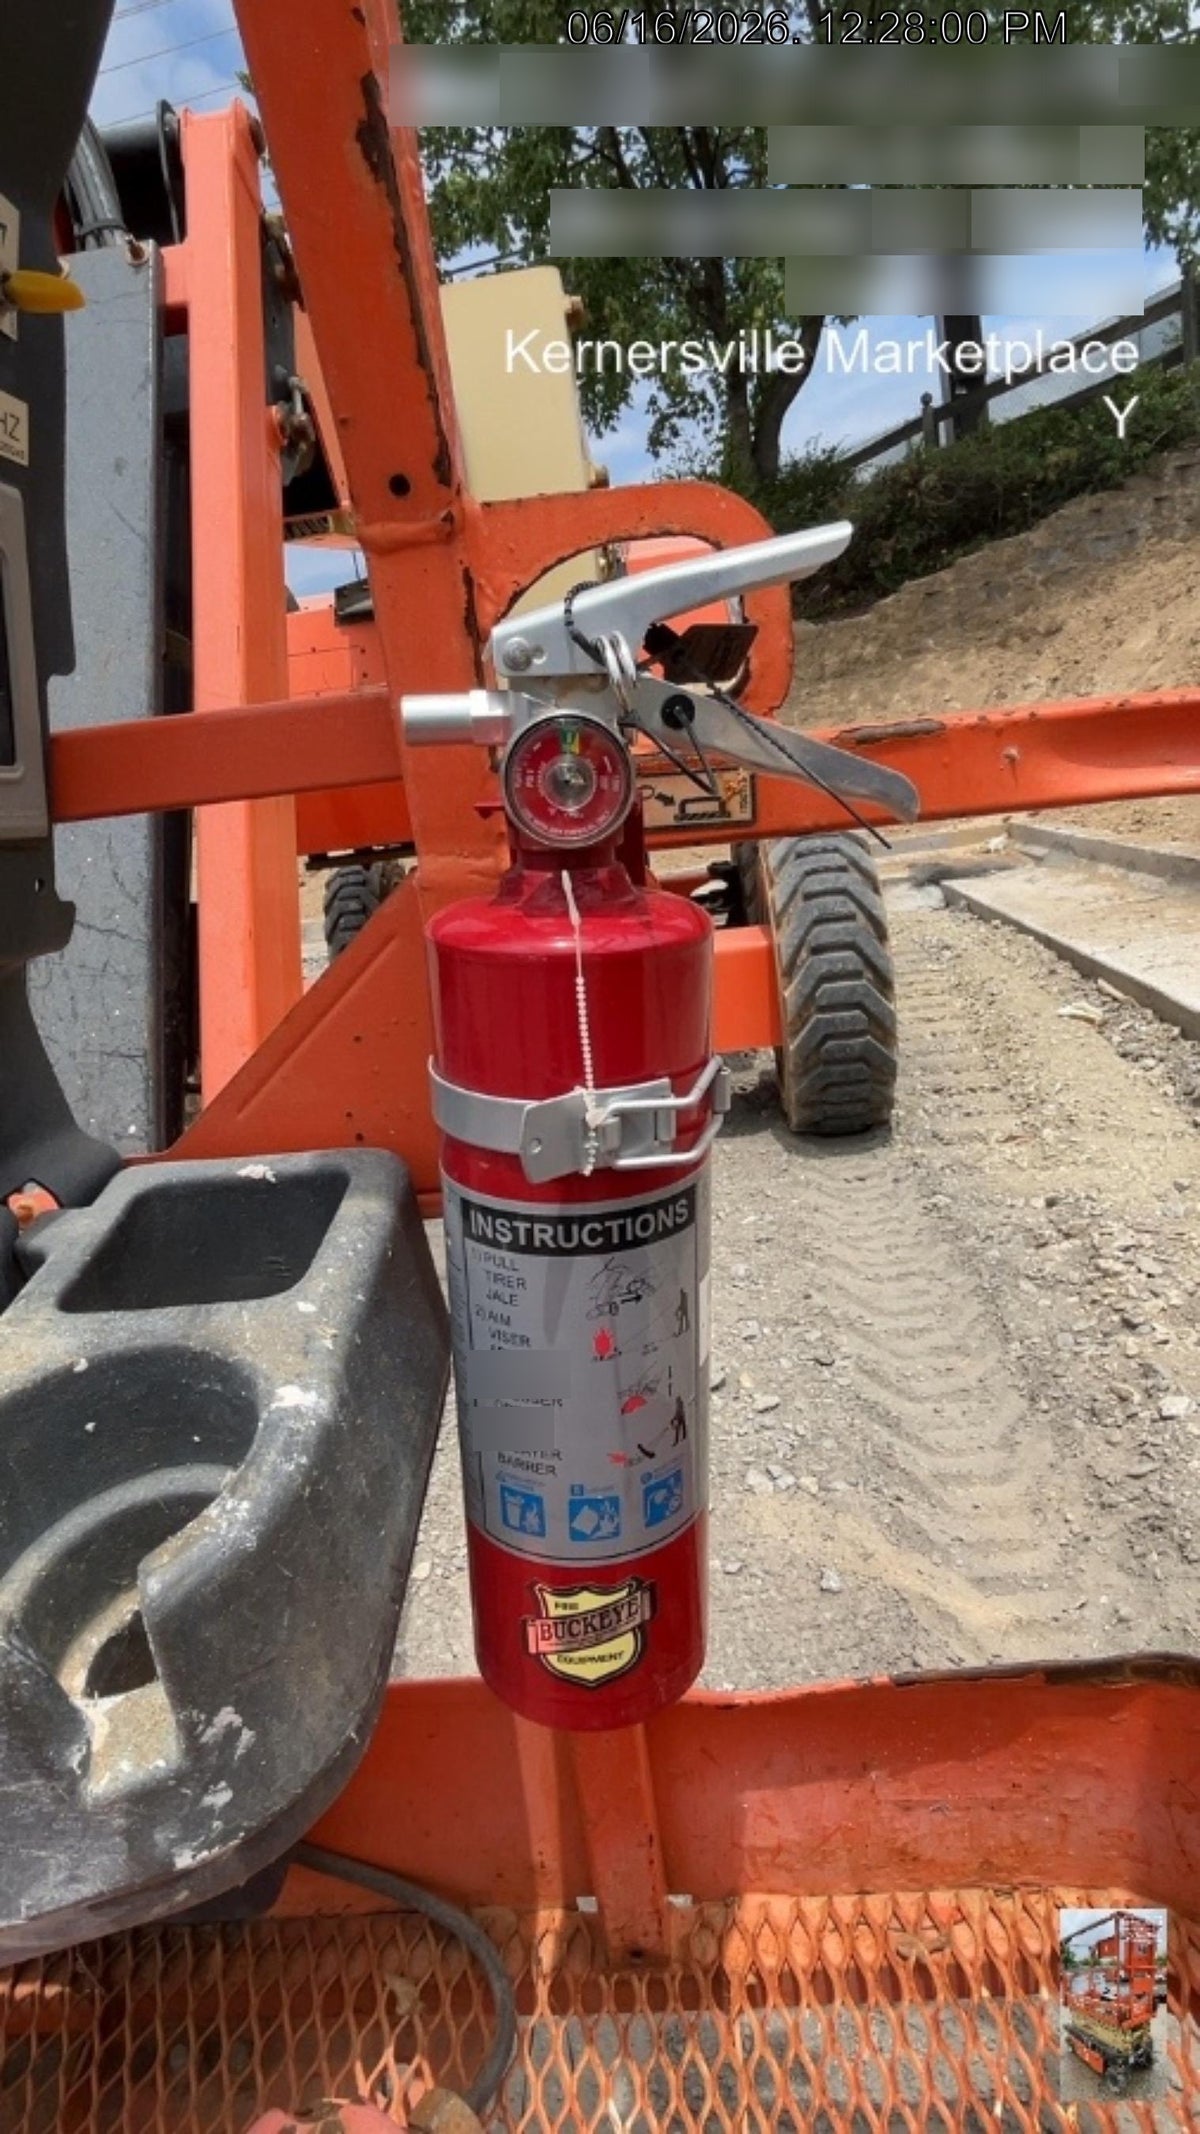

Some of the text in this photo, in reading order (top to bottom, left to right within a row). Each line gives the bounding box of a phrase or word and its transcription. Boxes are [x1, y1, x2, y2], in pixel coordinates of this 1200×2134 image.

[469, 1198, 689, 1249] INSTRUCTIONS
[485, 1269, 527, 1291] TIRER
[486, 1288, 518, 1307] JALE
[540, 1597, 640, 1642] BUCKEYE
[556, 1650, 625, 1666] EQUIPMENT
